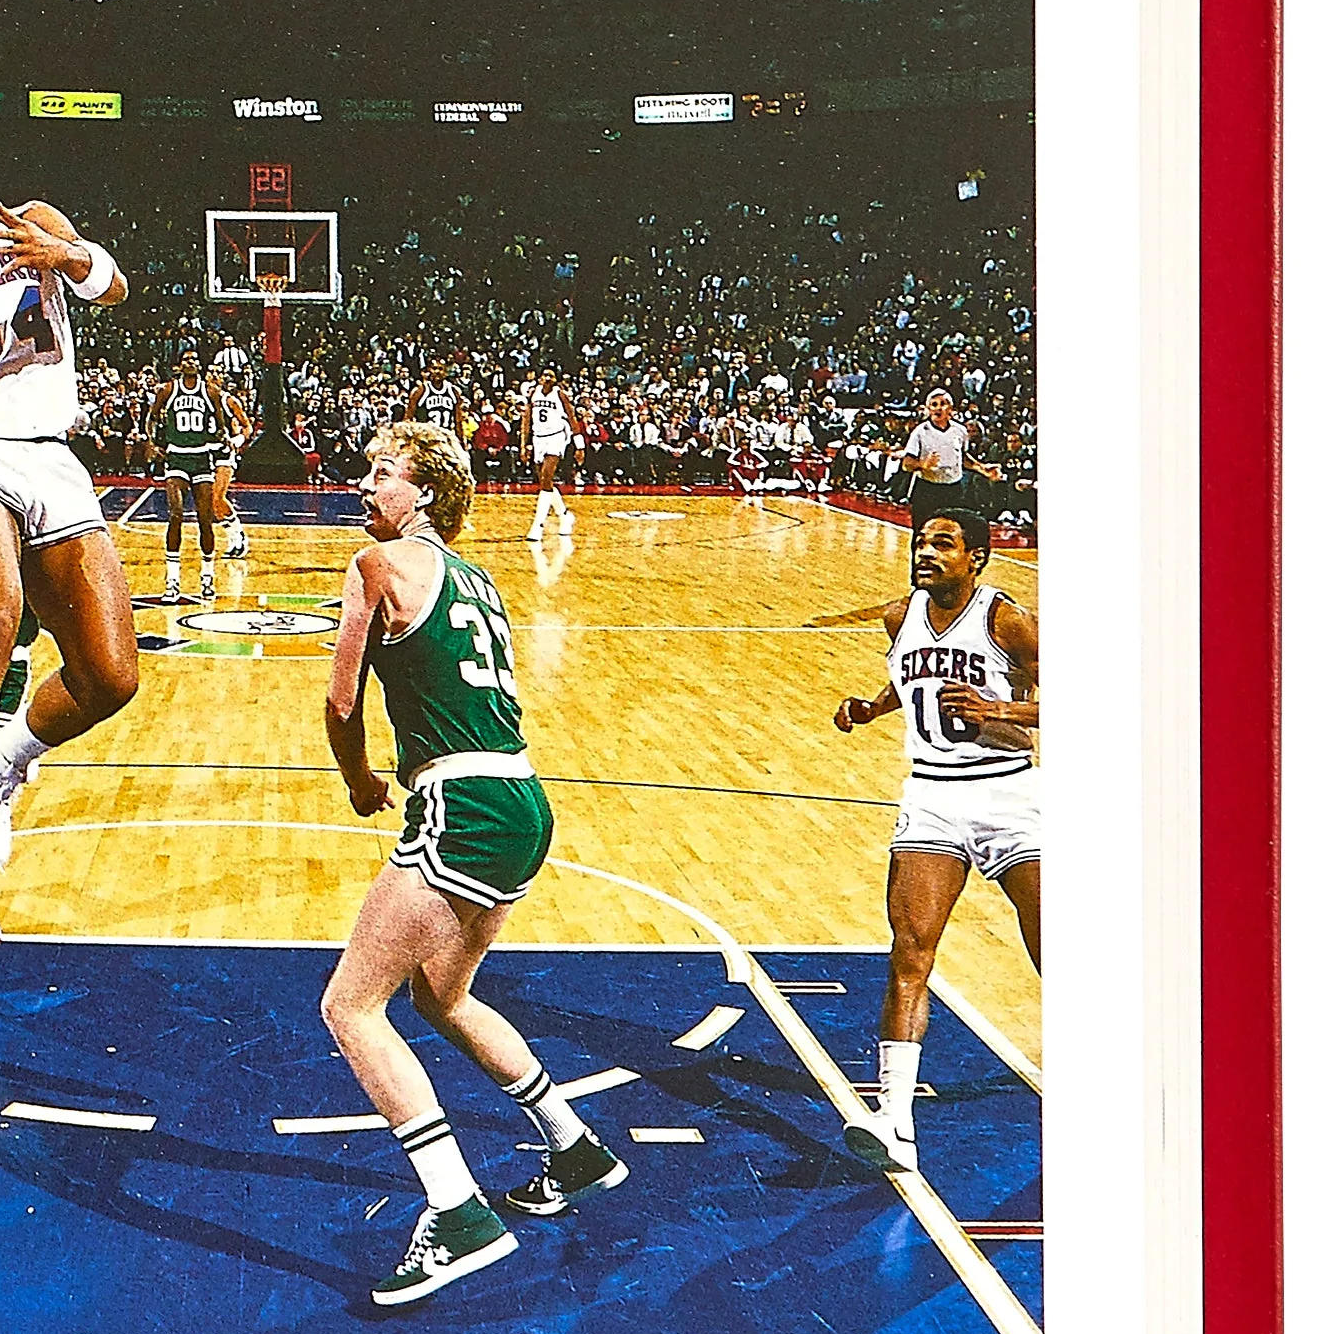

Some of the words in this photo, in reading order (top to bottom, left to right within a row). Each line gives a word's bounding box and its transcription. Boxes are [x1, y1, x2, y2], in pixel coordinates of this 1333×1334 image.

[233, 96, 319, 118] Winston
[255, 167, 286, 192] 22
[176, 410, 204, 432] 00
[539, 409, 548, 423] 6
[900, 646, 987, 688] SIXERS
